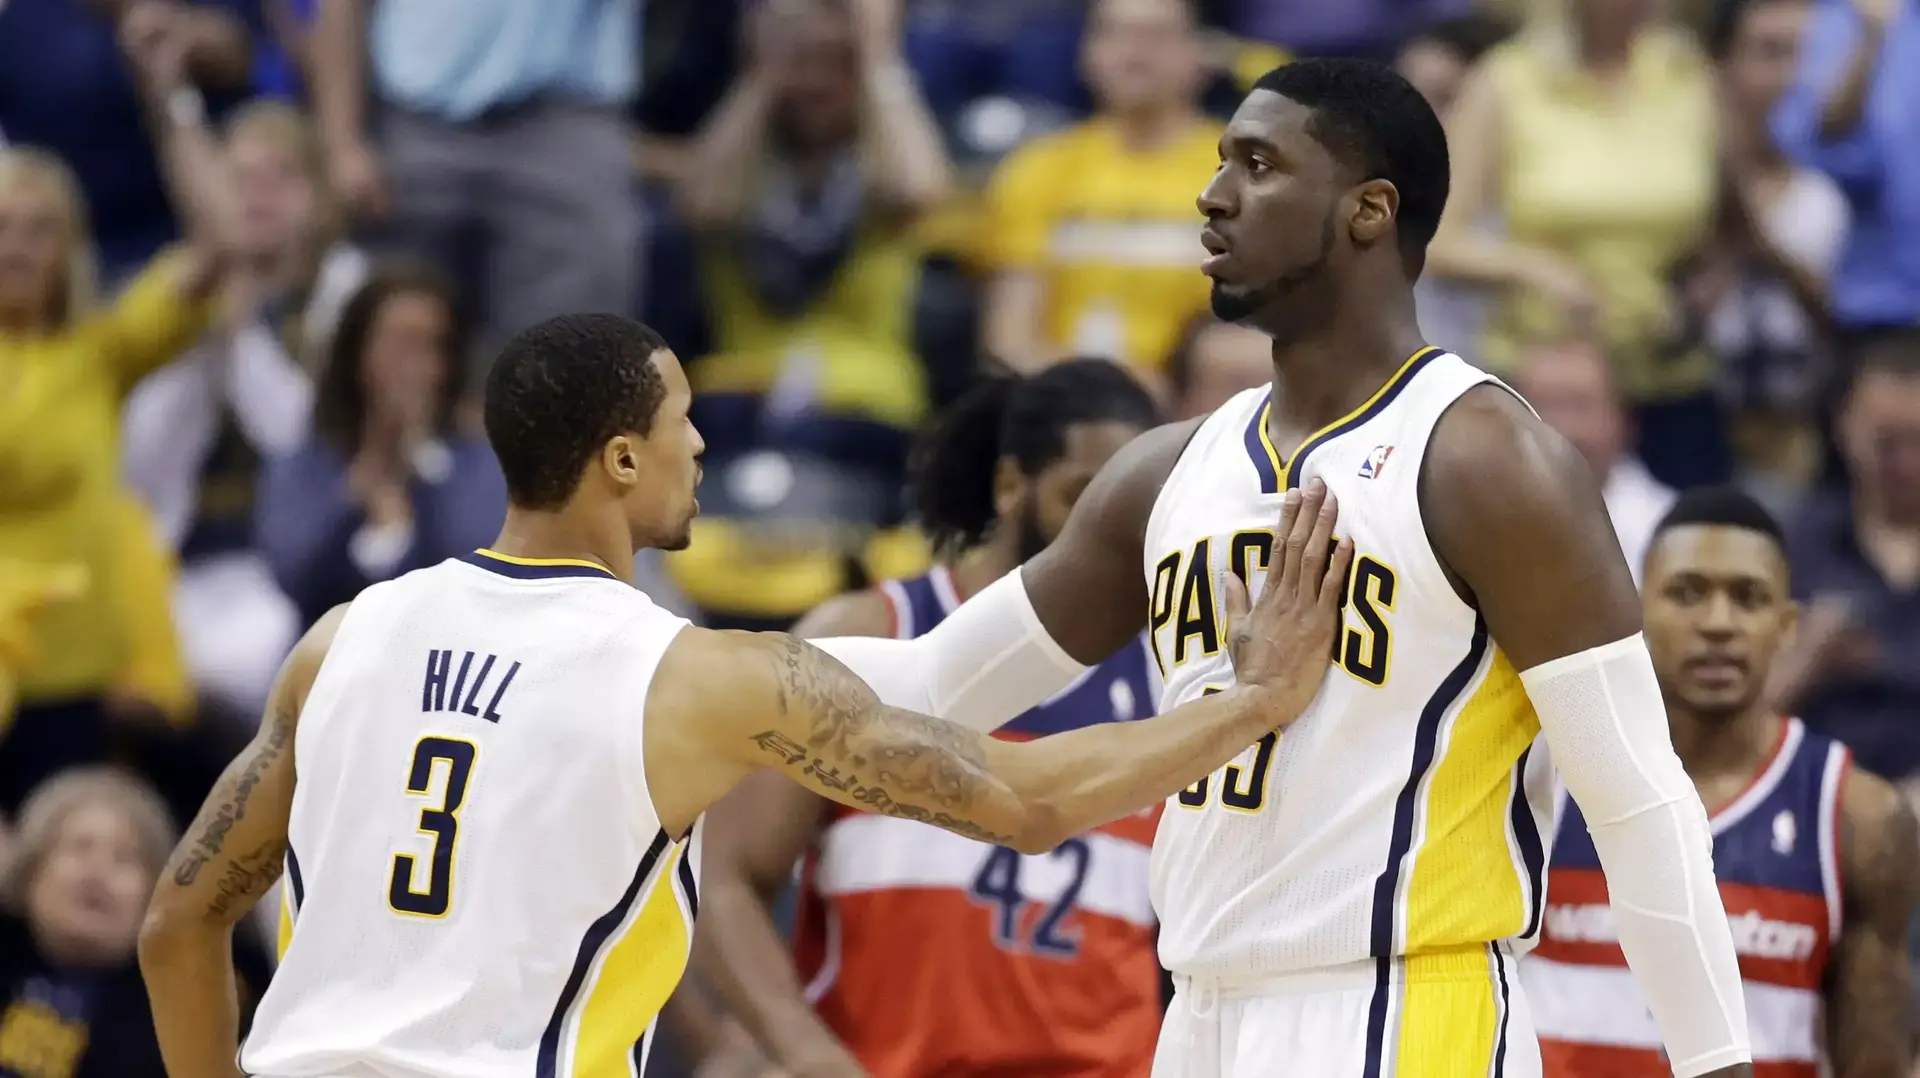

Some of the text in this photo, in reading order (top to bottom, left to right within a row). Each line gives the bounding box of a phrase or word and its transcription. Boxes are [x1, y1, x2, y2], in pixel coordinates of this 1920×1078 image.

[1149, 528, 1398, 689] PACS
[421, 649, 522, 724] HILL
[388, 734, 479, 919] 3
[969, 836, 1090, 955] 42
